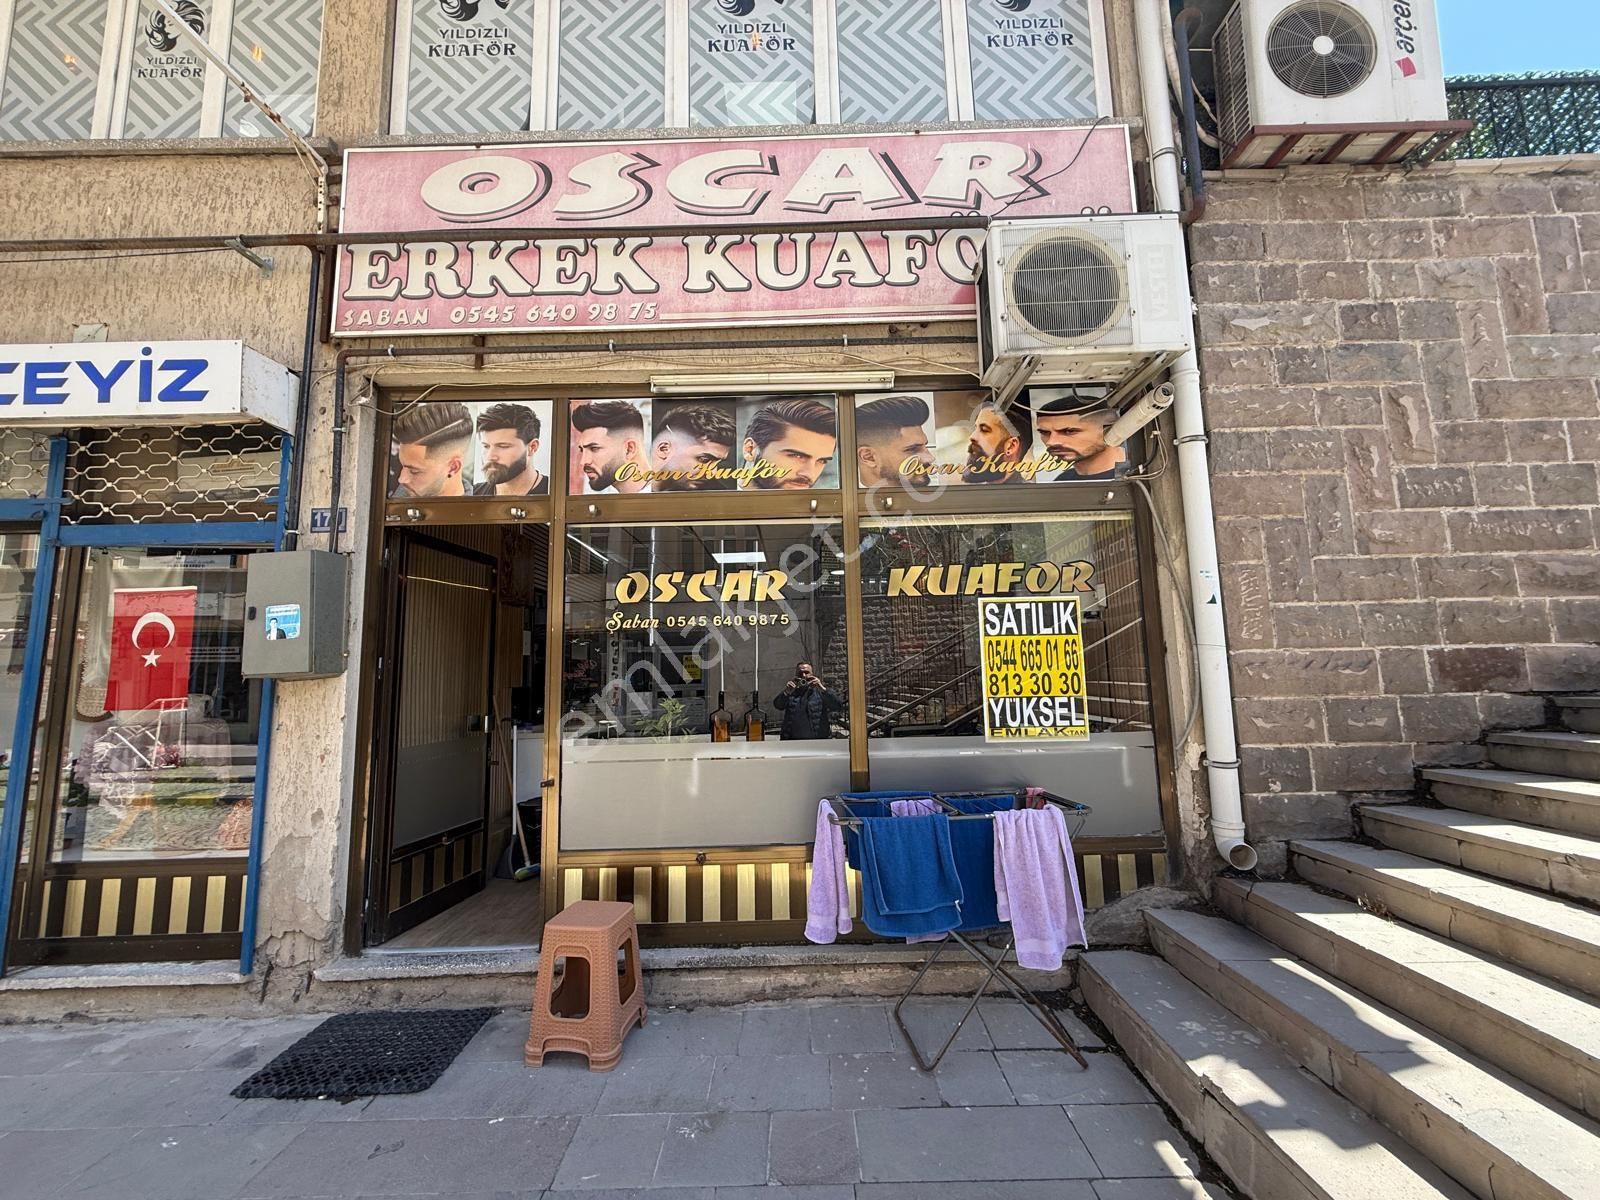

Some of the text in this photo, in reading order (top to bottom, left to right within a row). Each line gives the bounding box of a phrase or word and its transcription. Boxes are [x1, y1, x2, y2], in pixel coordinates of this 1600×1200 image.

[438, 28, 509, 40] YILDIZLI
[717, 22, 787, 34] YILDIZLI
[994, 18, 1064, 30] YILDIZLI
[427, 42, 517, 58] KUAFÖR
[707, 36, 797, 53] KUAFÖR
[986, 30, 1075, 48] KUAFÖR
[137, 67, 203, 79] KUAFÖR
[146, 56, 199, 66] YILDIZLI
[421, 141, 1050, 224] OSCAR
[343, 208, 1000, 300] ERKEK KUAFÖ
[449, 304, 517, 325] 0545
[526, 303, 578, 323] 640
[588, 302, 618, 322] 98
[628, 301, 659, 320] 75
[613, 458, 794, 487] Oscar Kuaför
[899, 451, 1076, 481] Oscar Kuaför
[615, 569, 790, 604] OSCAR
[886, 560, 1097, 598] KUAFOR
[606, 611, 790, 635] Şaban 0545 640 9875
[985, 602, 1078, 636] SATILIK
[987, 638, 1079, 672] 0544 665 01 66
[989, 672, 1081, 696] 813 30 30
[989, 696, 1085, 728] YÜKSEL
